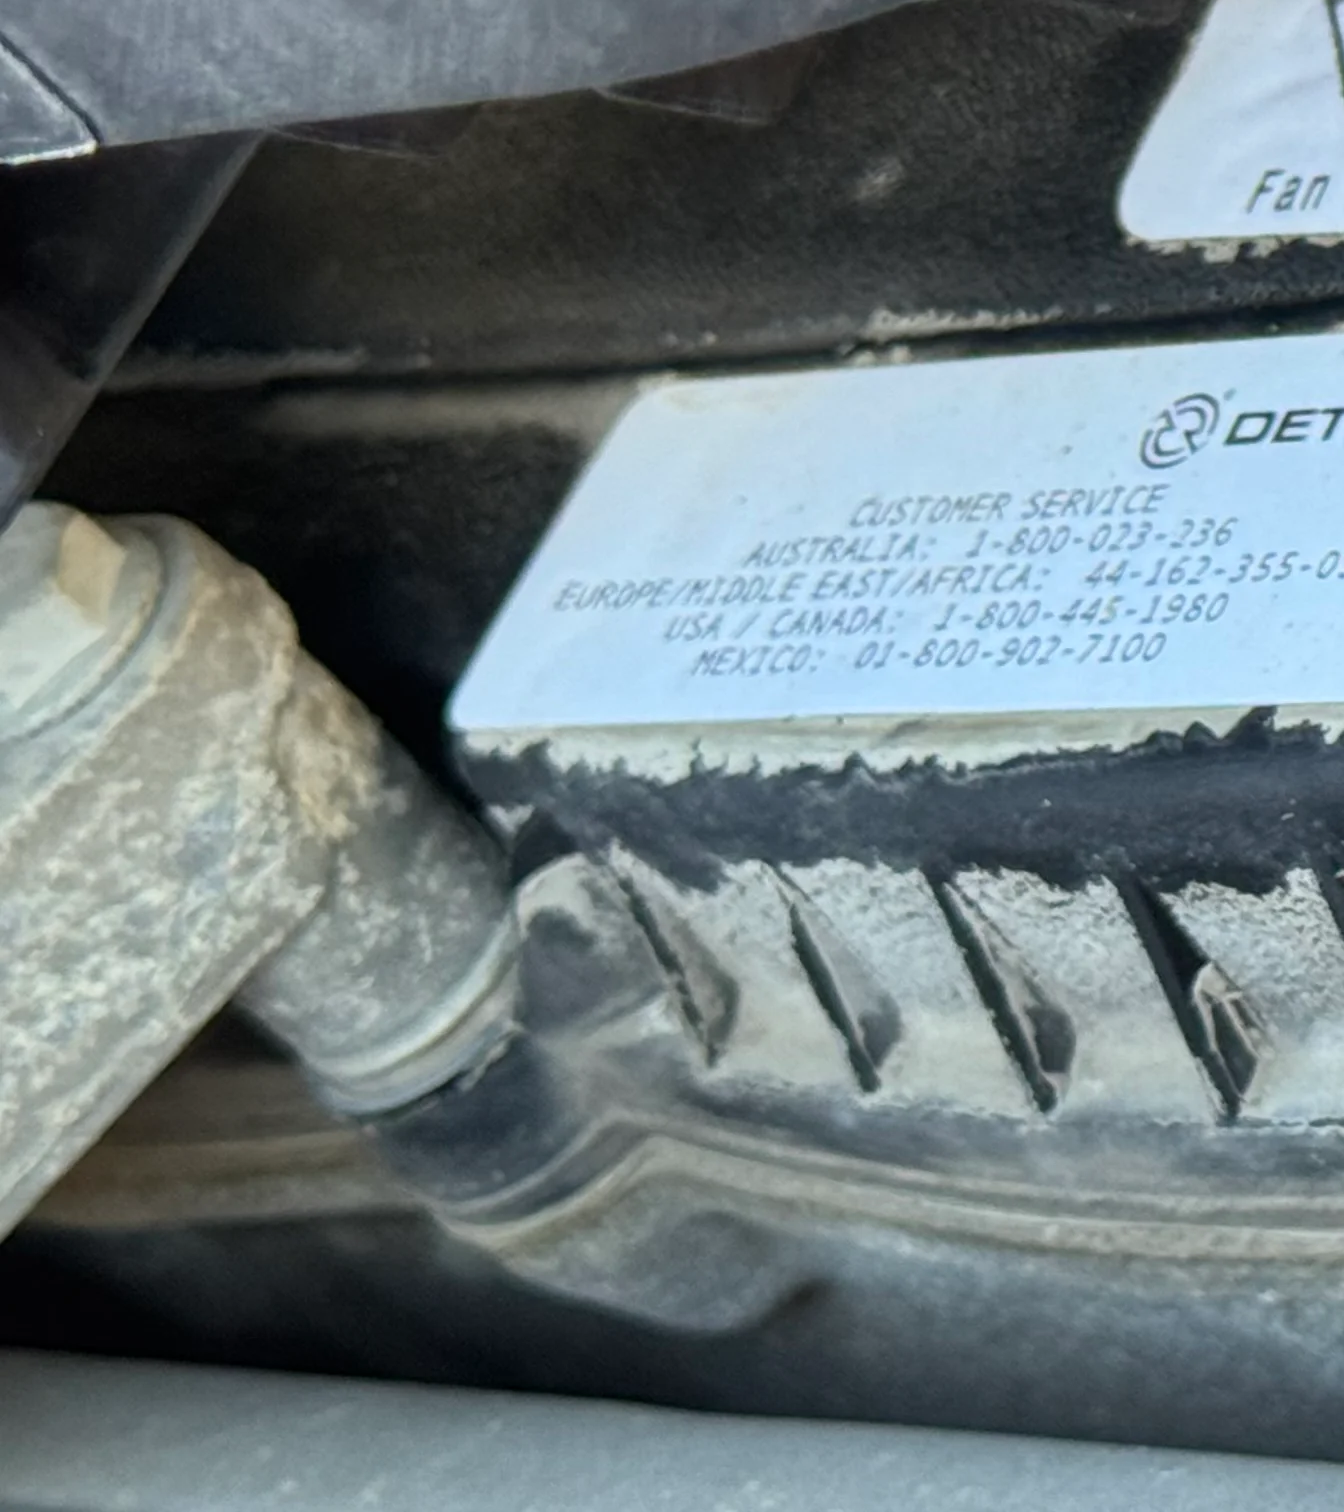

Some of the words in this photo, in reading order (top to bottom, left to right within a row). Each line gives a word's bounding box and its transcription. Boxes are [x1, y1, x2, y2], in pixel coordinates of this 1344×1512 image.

[1246, 168, 1330, 214] Fan
[849, 491, 1011, 528] CUSTOMER
[1020, 484, 1170, 520] SERVICE
[742, 532, 936, 568] AUSTRALIA:
[965, 517, 1237, 558] 1-800-023-236
[553, 570, 808, 611] EUROPE/MIDDLE
[809, 563, 1052, 601] EAST/AFRICA:
[663, 611, 726, 642] USA
[768, 605, 905, 639] CANADA:
[934, 592, 1230, 632] 1-800-445-1980
[691, 643, 827, 677] MEXICO:
[853, 631, 1167, 671] 01-800-902-7100
